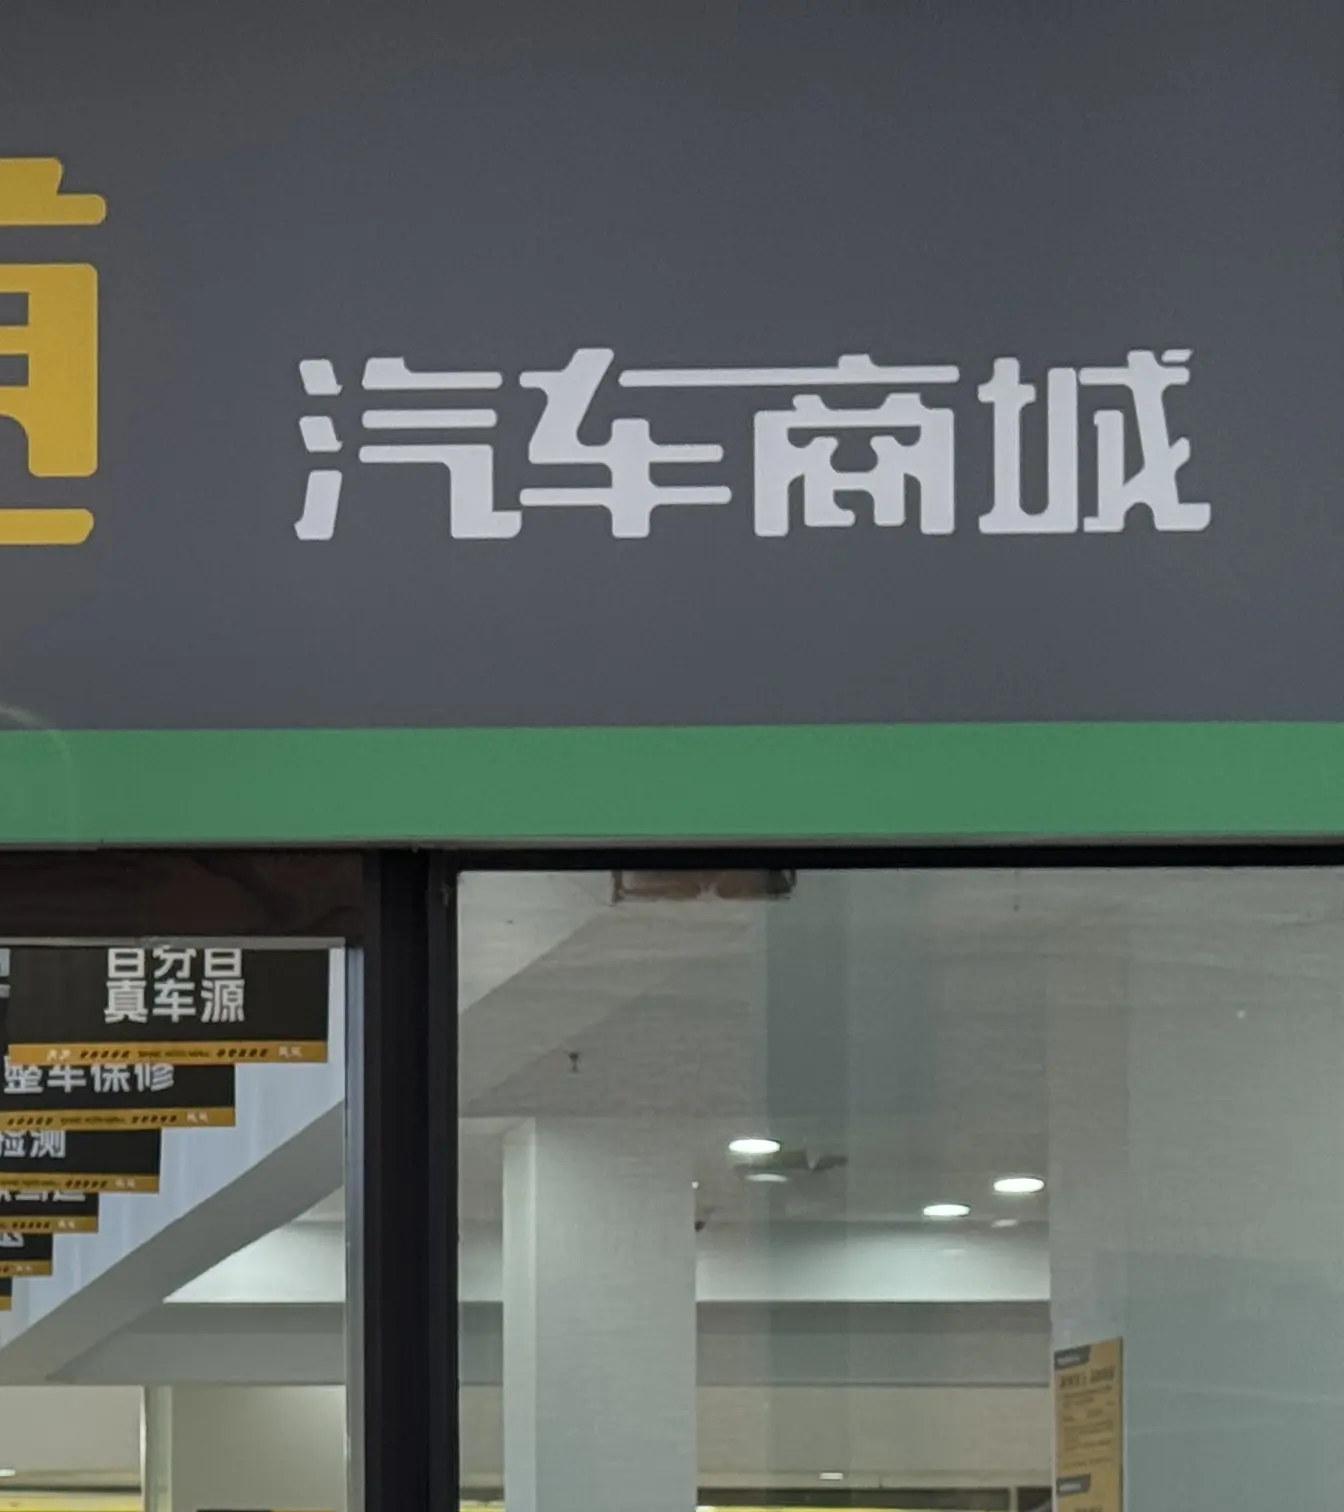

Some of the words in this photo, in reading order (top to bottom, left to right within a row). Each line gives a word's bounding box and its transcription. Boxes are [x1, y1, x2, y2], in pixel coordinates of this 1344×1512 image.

[293, 346, 1212, 540] 汽车商城
[104, 979, 246, 1024] 真车源
